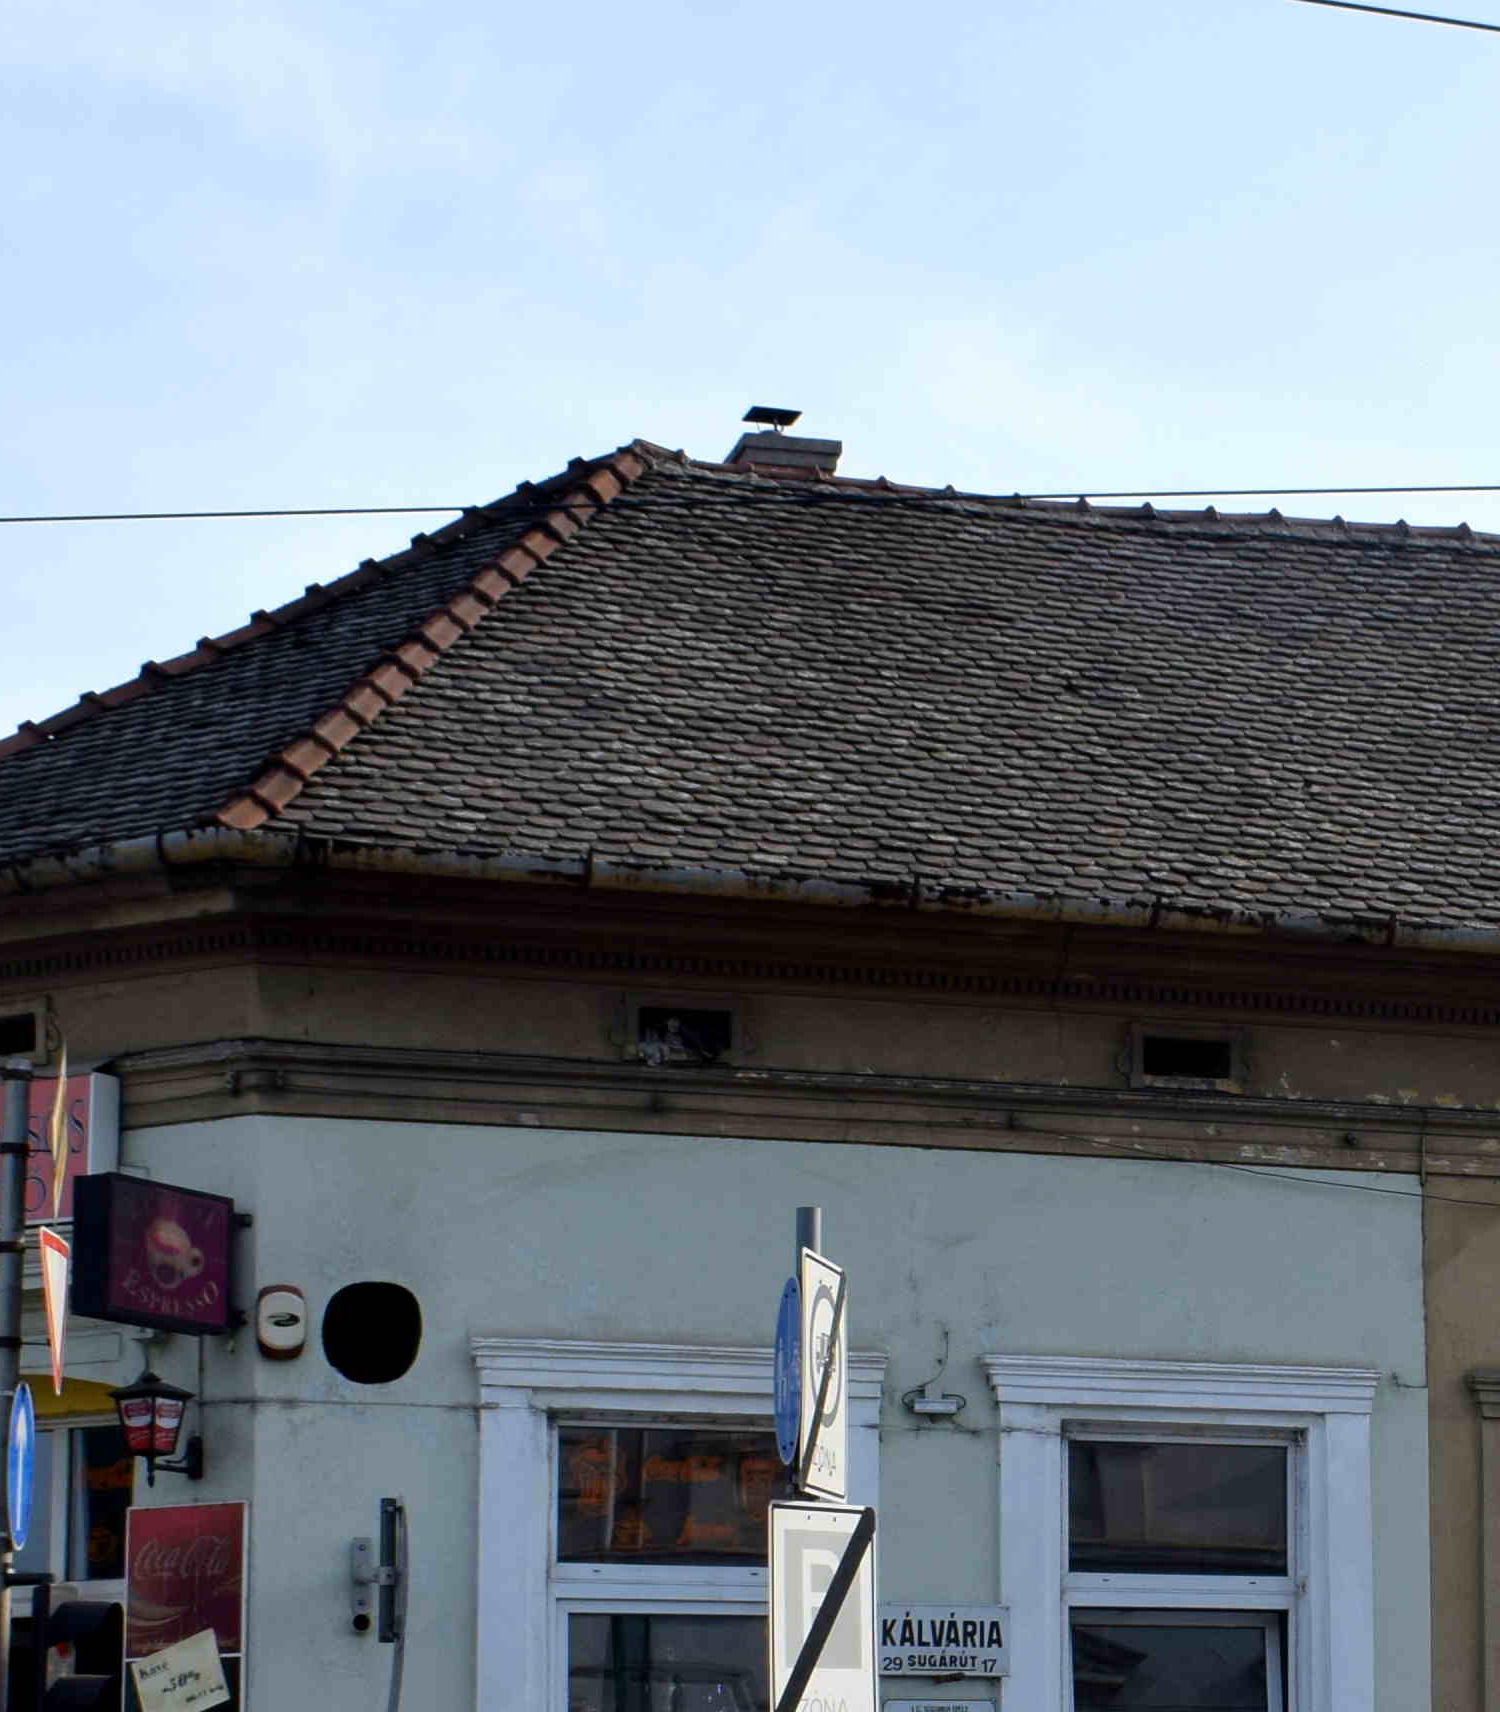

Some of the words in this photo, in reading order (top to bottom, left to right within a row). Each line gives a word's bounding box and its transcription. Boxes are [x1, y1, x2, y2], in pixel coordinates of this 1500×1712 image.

[881, 1611, 1003, 1648] KÁLVÁRIA
[883, 1656, 903, 1671] 29
[907, 1649, 978, 1668] SUGÁRÚT
[981, 1658, 997, 1673] 17
